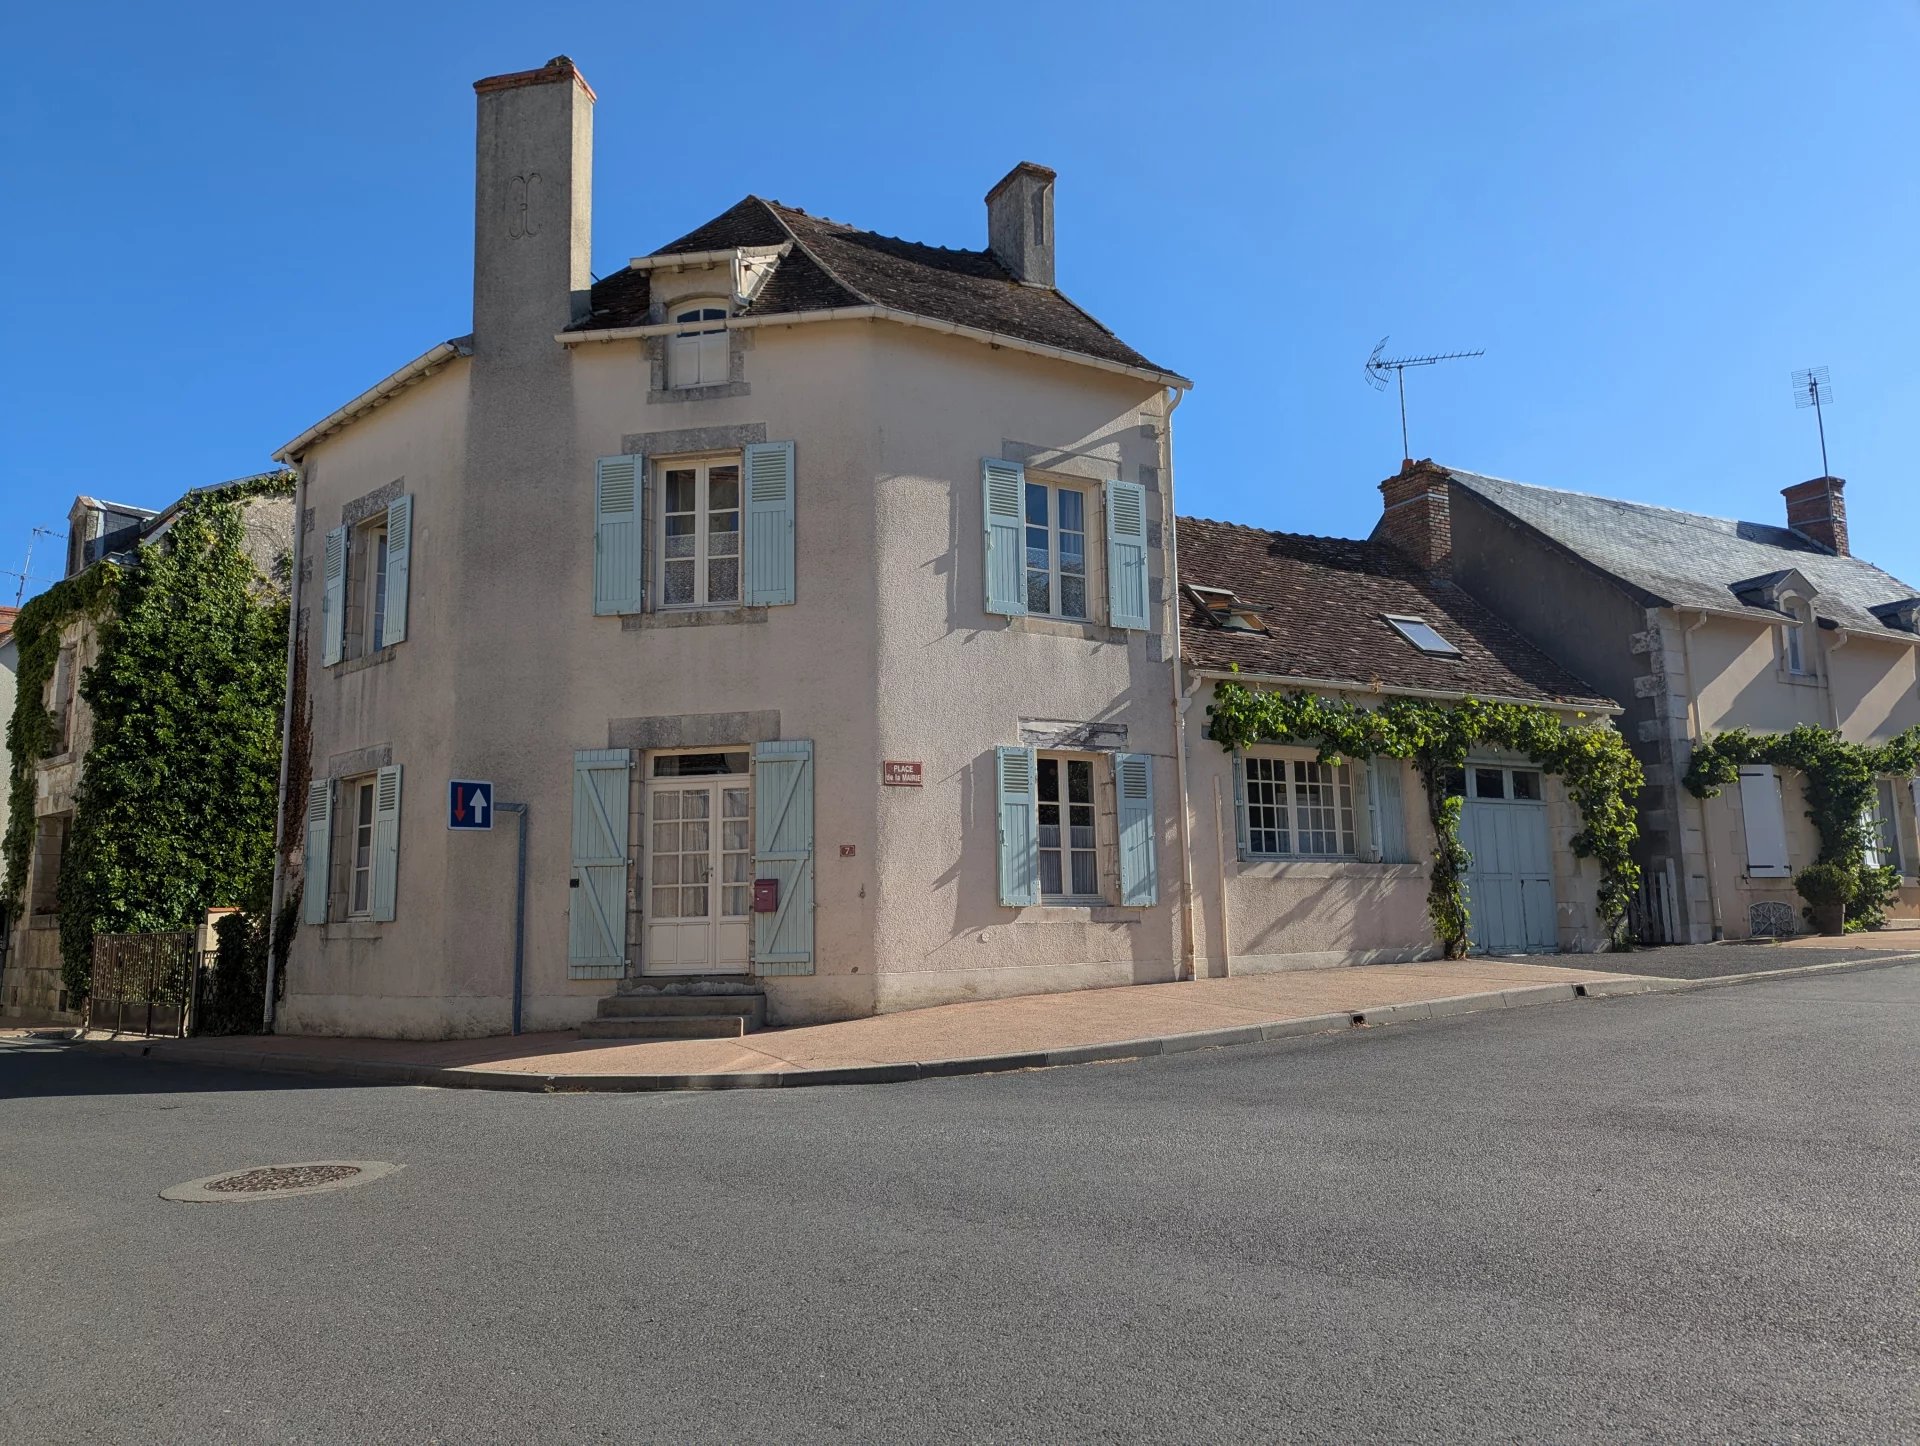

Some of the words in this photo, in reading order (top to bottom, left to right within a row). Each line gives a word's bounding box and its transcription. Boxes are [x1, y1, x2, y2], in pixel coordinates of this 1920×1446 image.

[893, 765, 914, 773] PLACE
[902, 774, 921, 782] MAIRIE
[844, 847, 850, 855] 7
